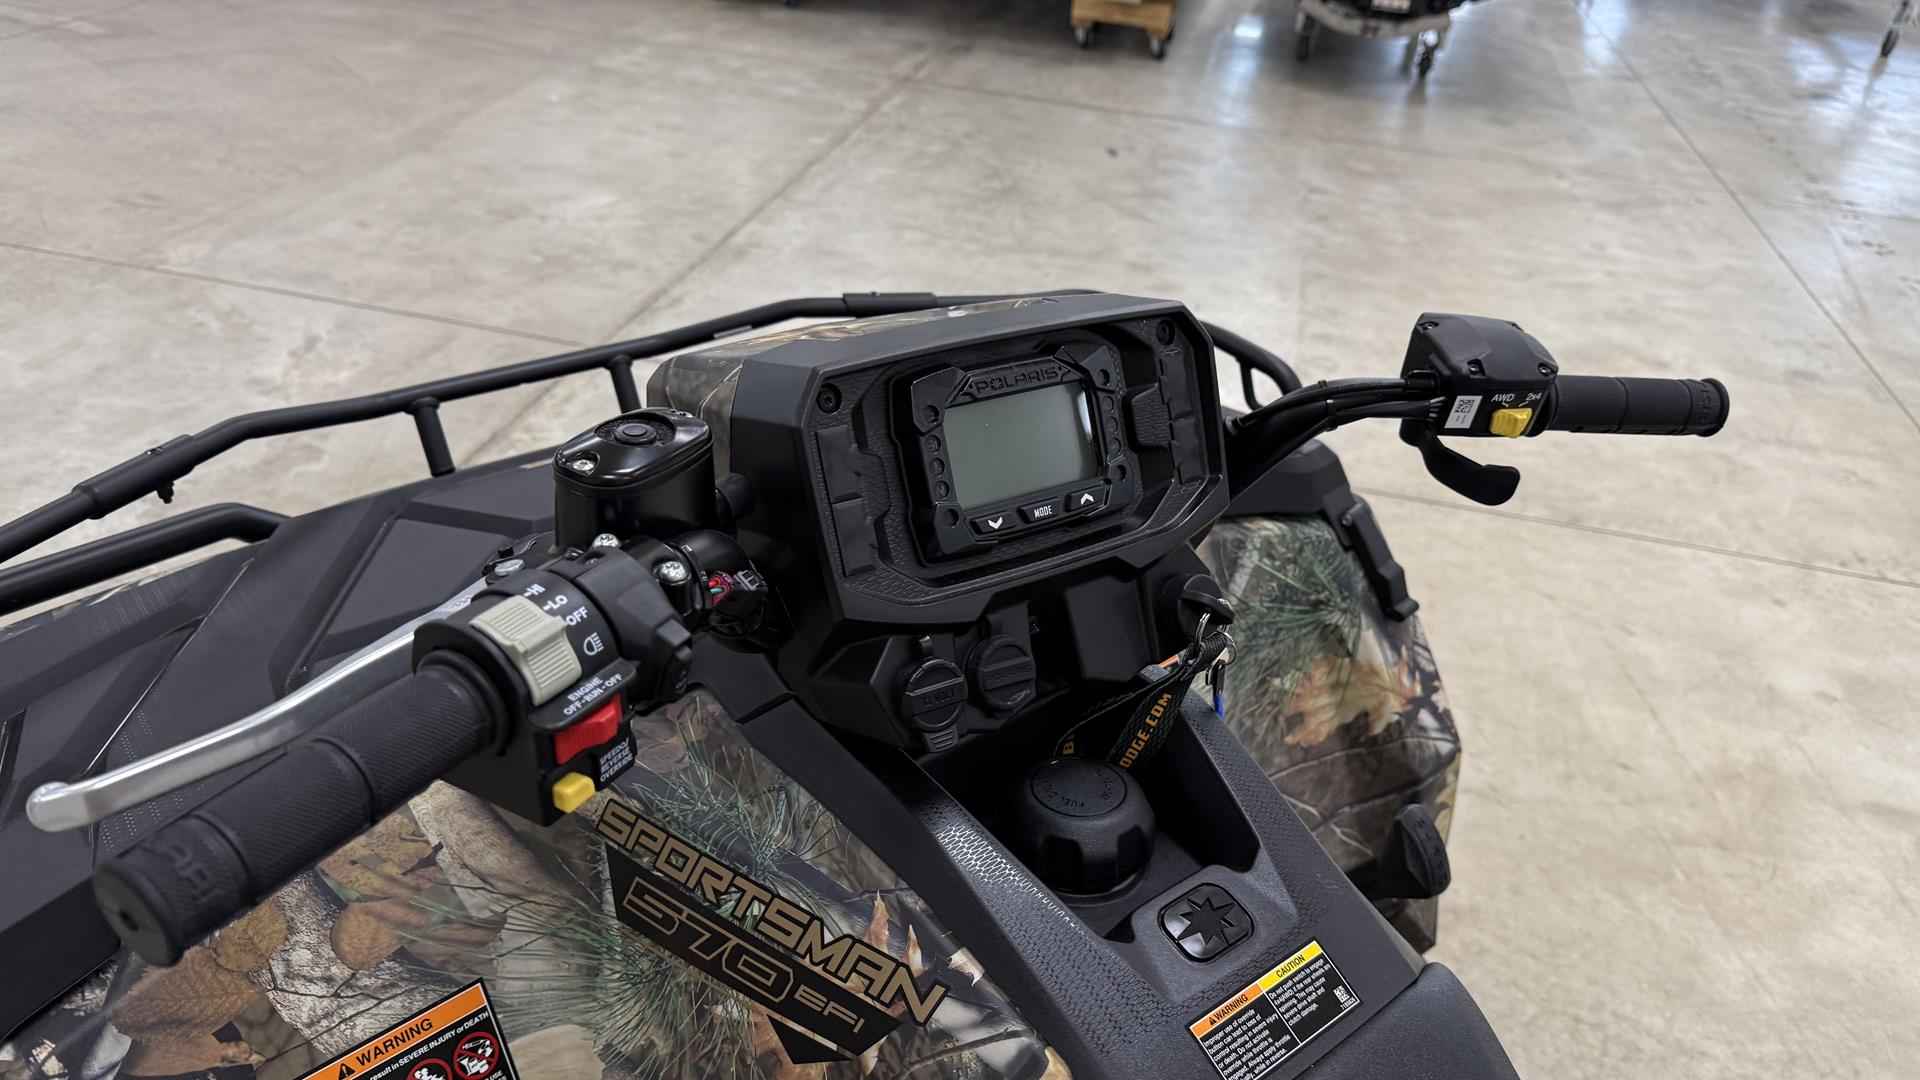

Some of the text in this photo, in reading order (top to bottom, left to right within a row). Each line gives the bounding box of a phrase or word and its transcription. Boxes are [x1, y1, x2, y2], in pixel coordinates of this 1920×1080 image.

[974, 366, 1059, 393] POLARIS
[1491, 392, 1542, 402] AWD 2x4
[1034, 505, 1052, 518] MODE
[566, 606, 588, 626] OFF
[568, 677, 603, 701] ENGINE
[600, 737, 629, 765] SPEEDO/
[601, 746, 631, 773] REVERSE
[601, 753, 633, 781] OVERRIDE
[599, 801, 949, 1025] SPORTSMAN
[622, 877, 866, 1034] 570 EFI
[1275, 954, 1304, 977] CAUTION
[1268, 990, 1276, 999] Do
[1275, 986, 1283, 994] not
[1282, 979, 1293, 989] push
[1291, 970, 1305, 982] switch
[1309, 958, 1324, 971] engage
[1295, 981, 1303, 989] the
[1295, 989, 1305, 999] This
[1305, 984, 1315, 994] may
[1313, 976, 1325, 987] cause
[1315, 986, 1325, 995] and
[1214, 994, 1248, 1020] WARNING
[1287, 1012, 1301, 1025] clutch
[391, 1062, 400, 1071] in
[398, 1044, 430, 1066] SEVERE
[429, 1031, 456, 1051] INJURY
[456, 1026, 465, 1035] or
[464, 1011, 489, 1029] DEATH
[1204, 1030, 1225, 1048] Improper
[1223, 1024, 1233, 1033] use
[1236, 1008, 1255, 1023] override
[1208, 1040, 1224, 1054] button
[1223, 1034, 1233, 1043] can
[1231, 1027, 1242, 1037] lead
[1246, 1017, 1256, 1027] loss
[1212, 1046, 1230, 1061] control
[1229, 1033, 1249, 1051] resulting
[1252, 1021, 1266, 1033] severe
[1265, 1011, 1279, 1024] injury
[1237, 1045, 1245, 1054] Do
[1244, 1040, 1253, 1049] not
[1251, 1028, 1269, 1043] activate
[355, 1018, 433, 1066] WARNING
[1247, 1052, 1265, 1068] Always
[1262, 1044, 1277, 1057] apply
[1274, 1033, 1290, 1047] throttle
[1222, 1059, 1241, 1075] override
[1240, 1050, 1253, 1062] while
[1251, 1039, 1268, 1053] throttle
